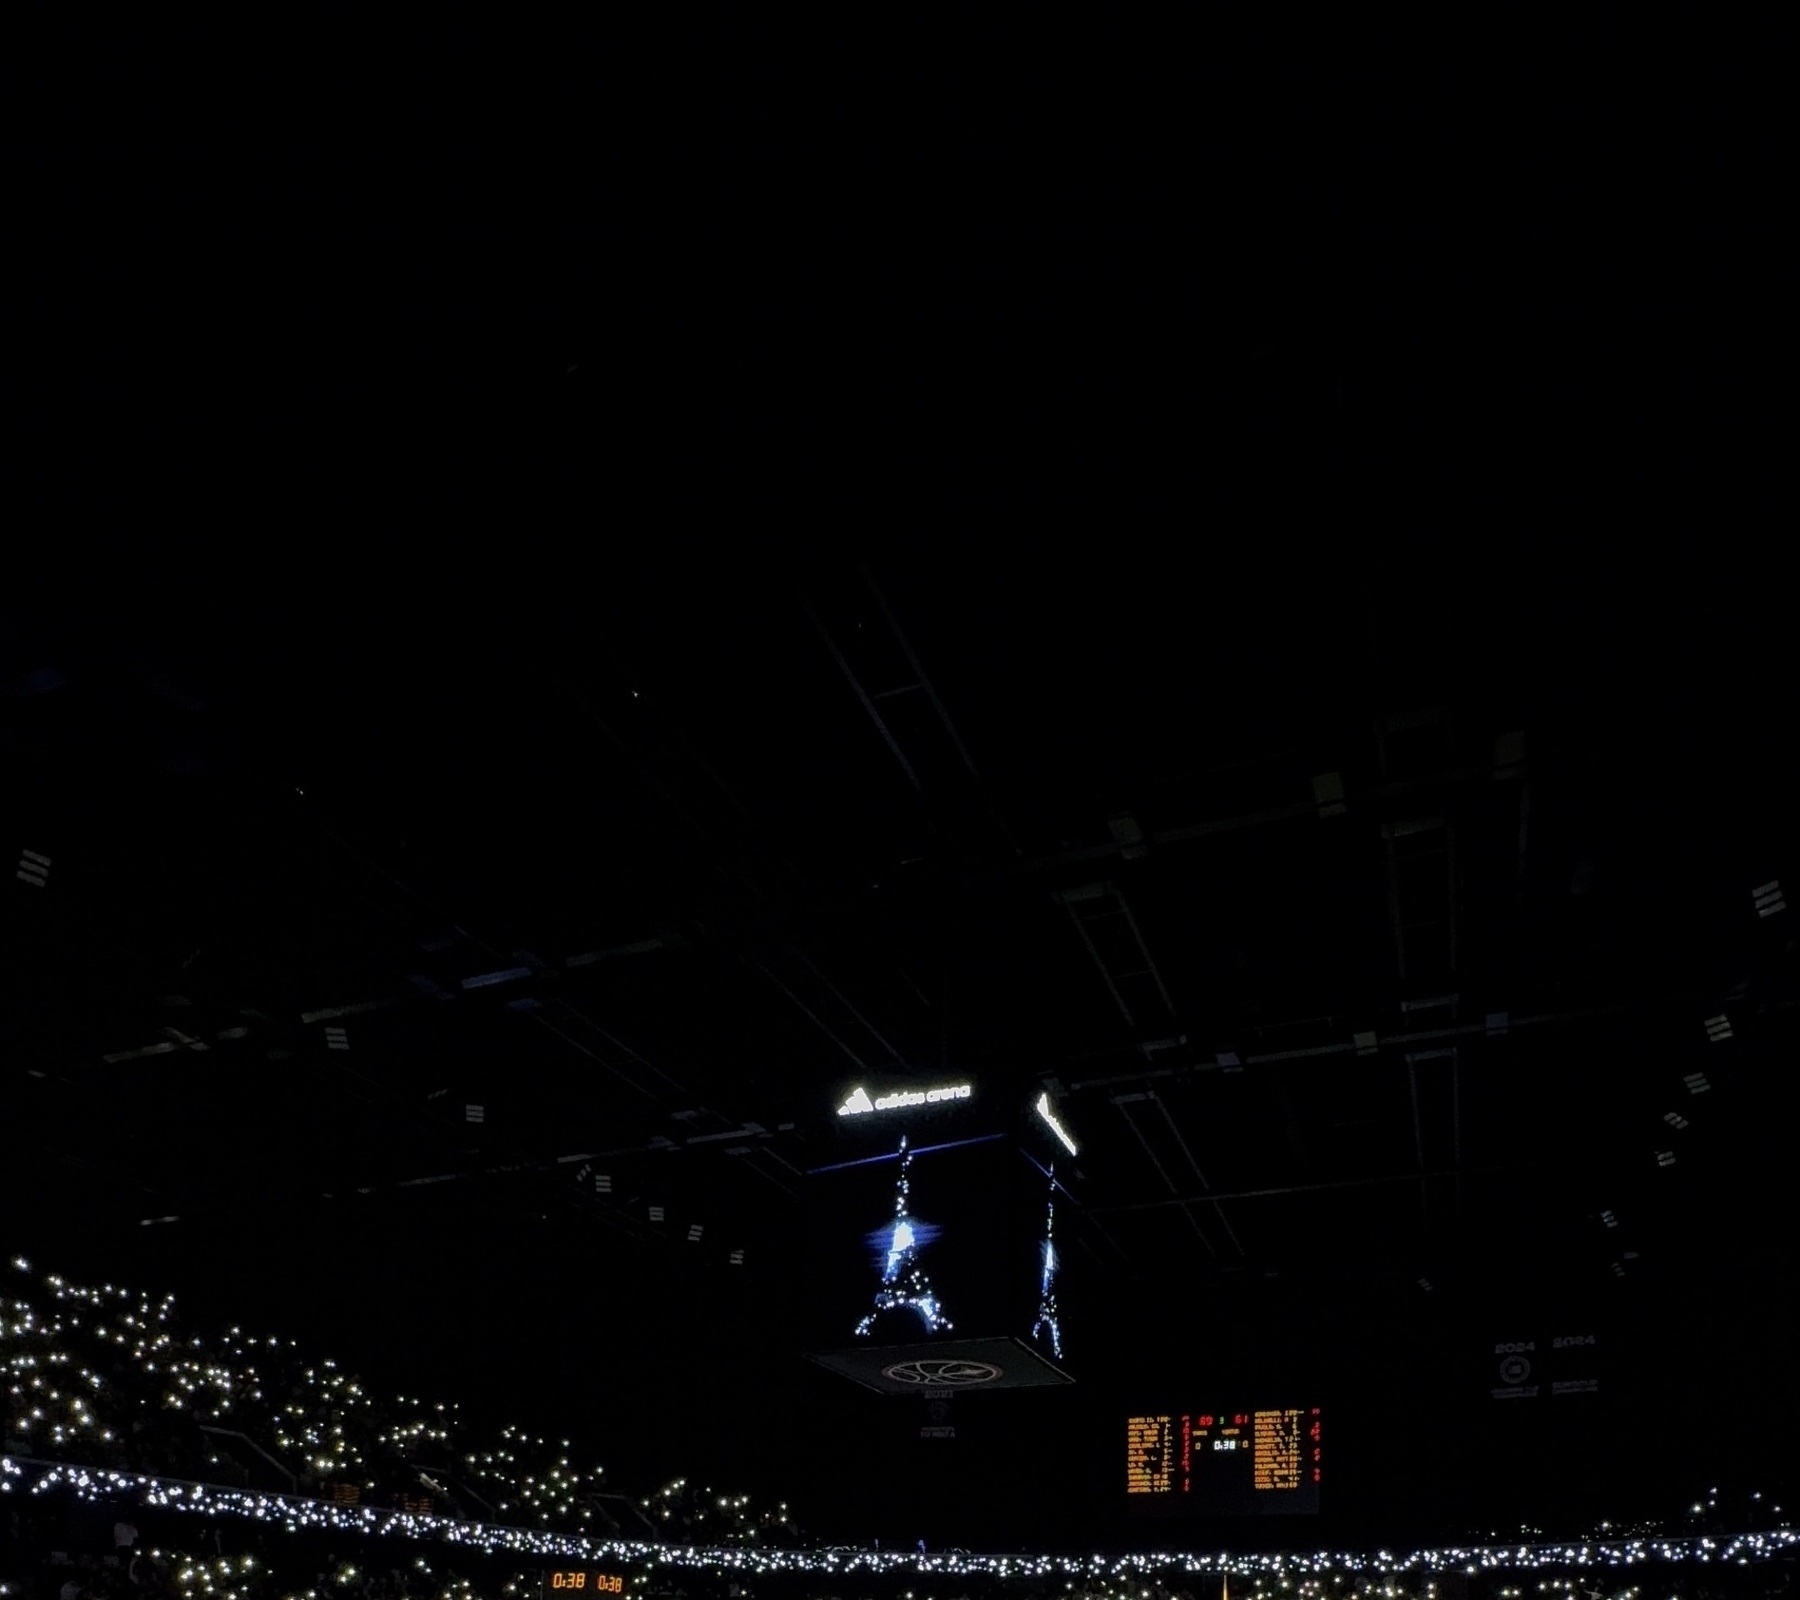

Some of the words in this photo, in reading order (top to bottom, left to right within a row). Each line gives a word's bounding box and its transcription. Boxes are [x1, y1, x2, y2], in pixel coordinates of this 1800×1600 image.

[875, 1092, 925, 1110] adidas
[926, 1085, 971, 1103] arena
[1235, 1415, 1248, 1424] 61
[553, 1572, 586, 1589] 0:38
[598, 1575, 623, 1593] 0:38
